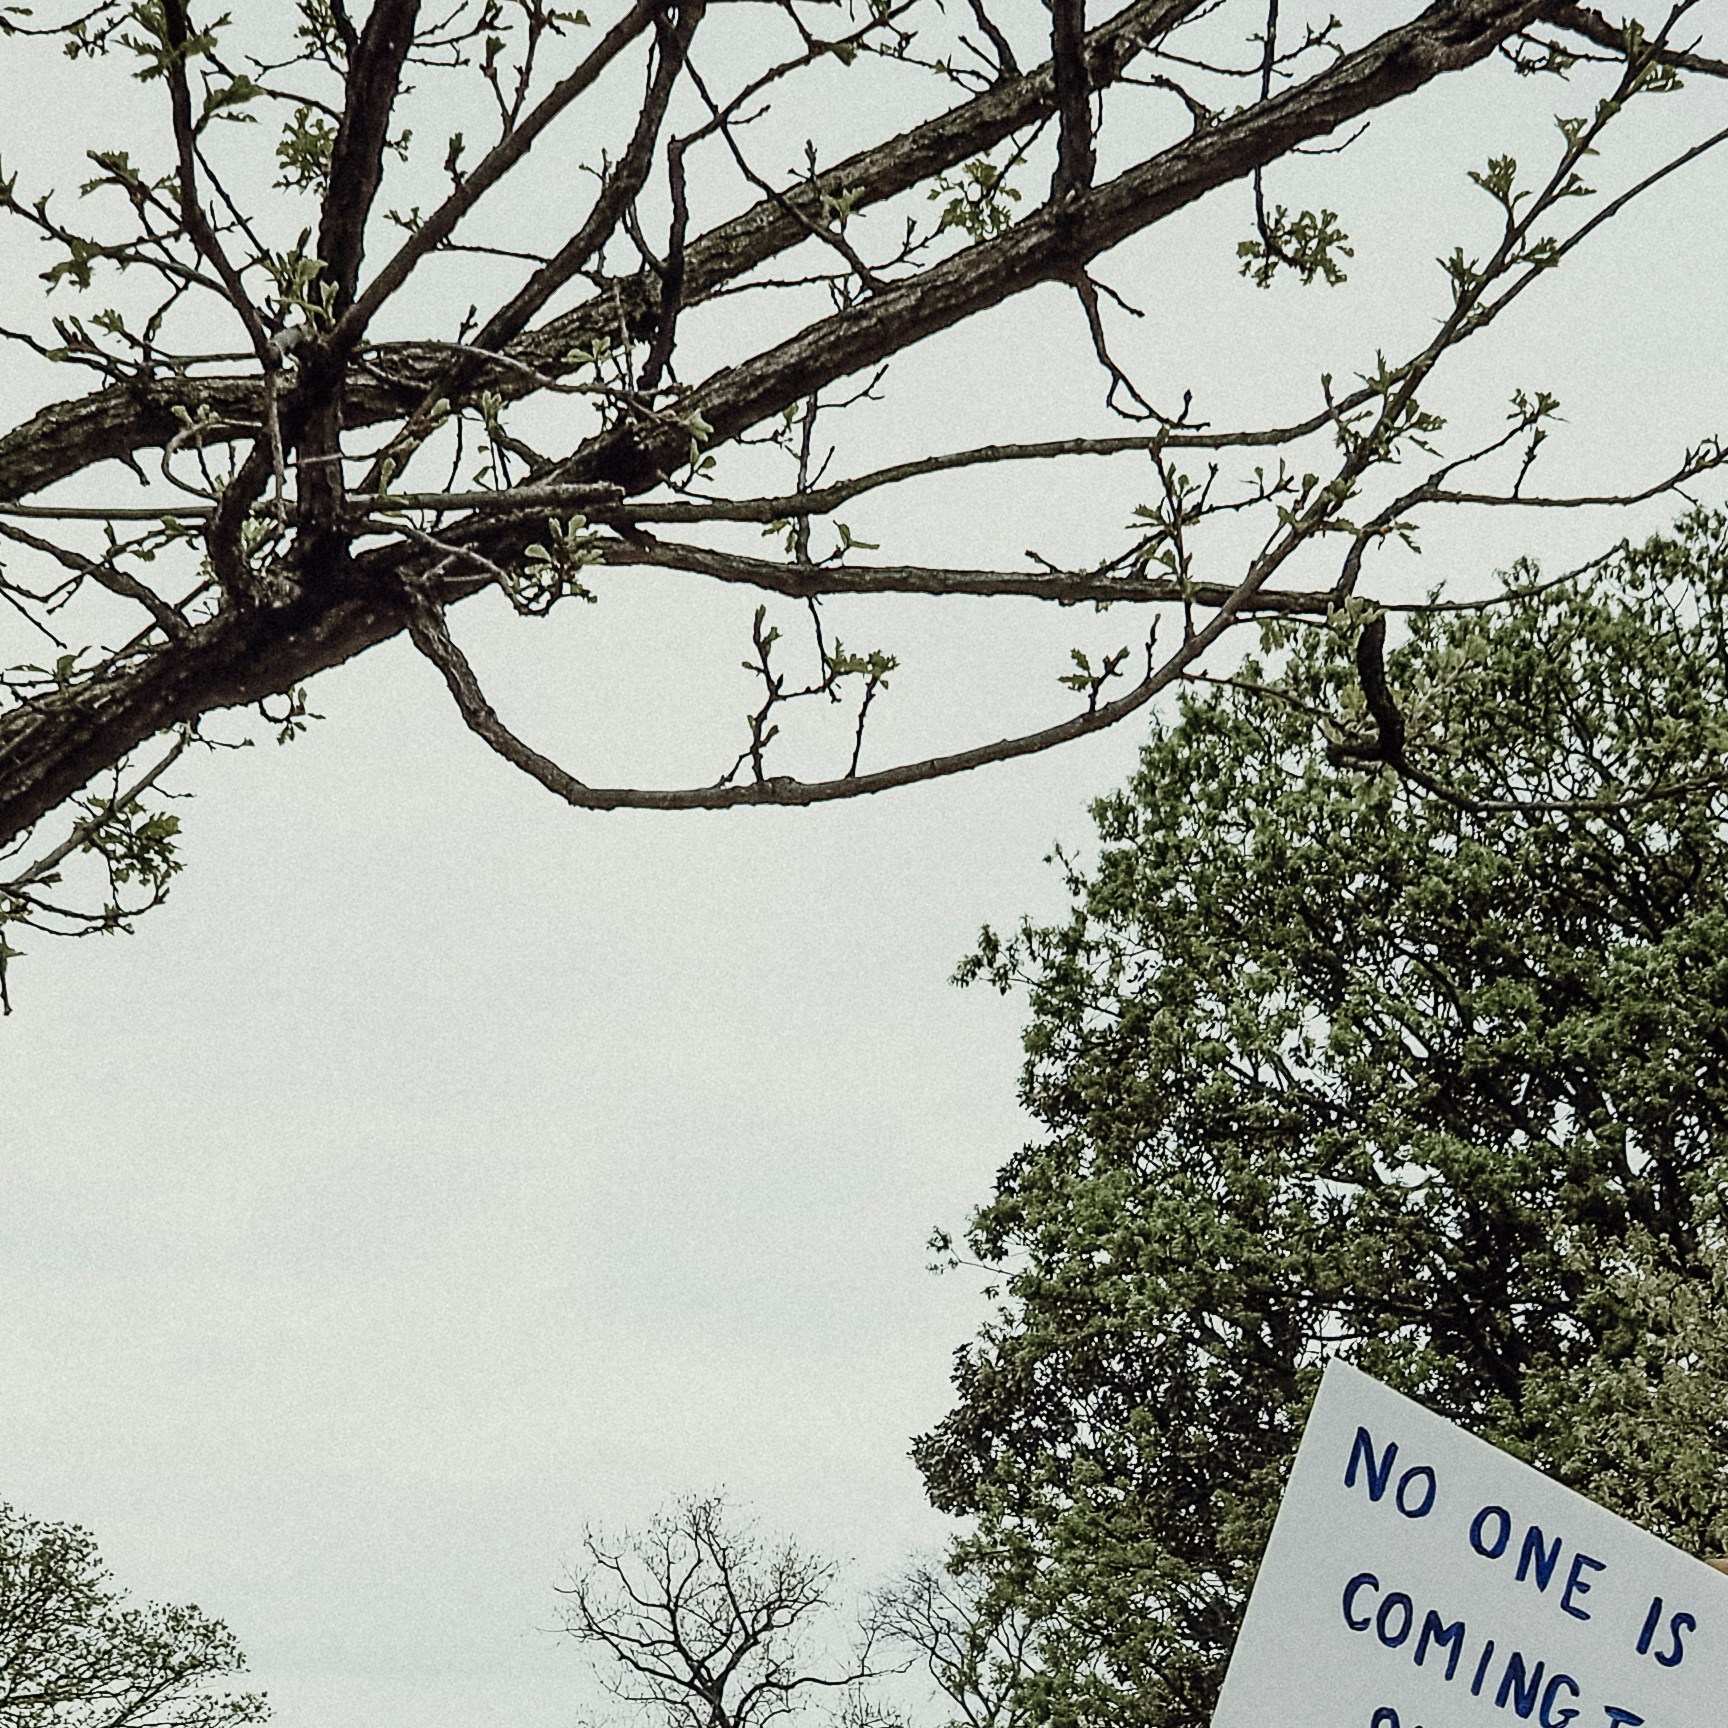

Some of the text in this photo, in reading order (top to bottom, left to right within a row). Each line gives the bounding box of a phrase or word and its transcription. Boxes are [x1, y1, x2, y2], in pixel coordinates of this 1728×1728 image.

[1344, 1426, 1696, 1667] NO ONE IS
